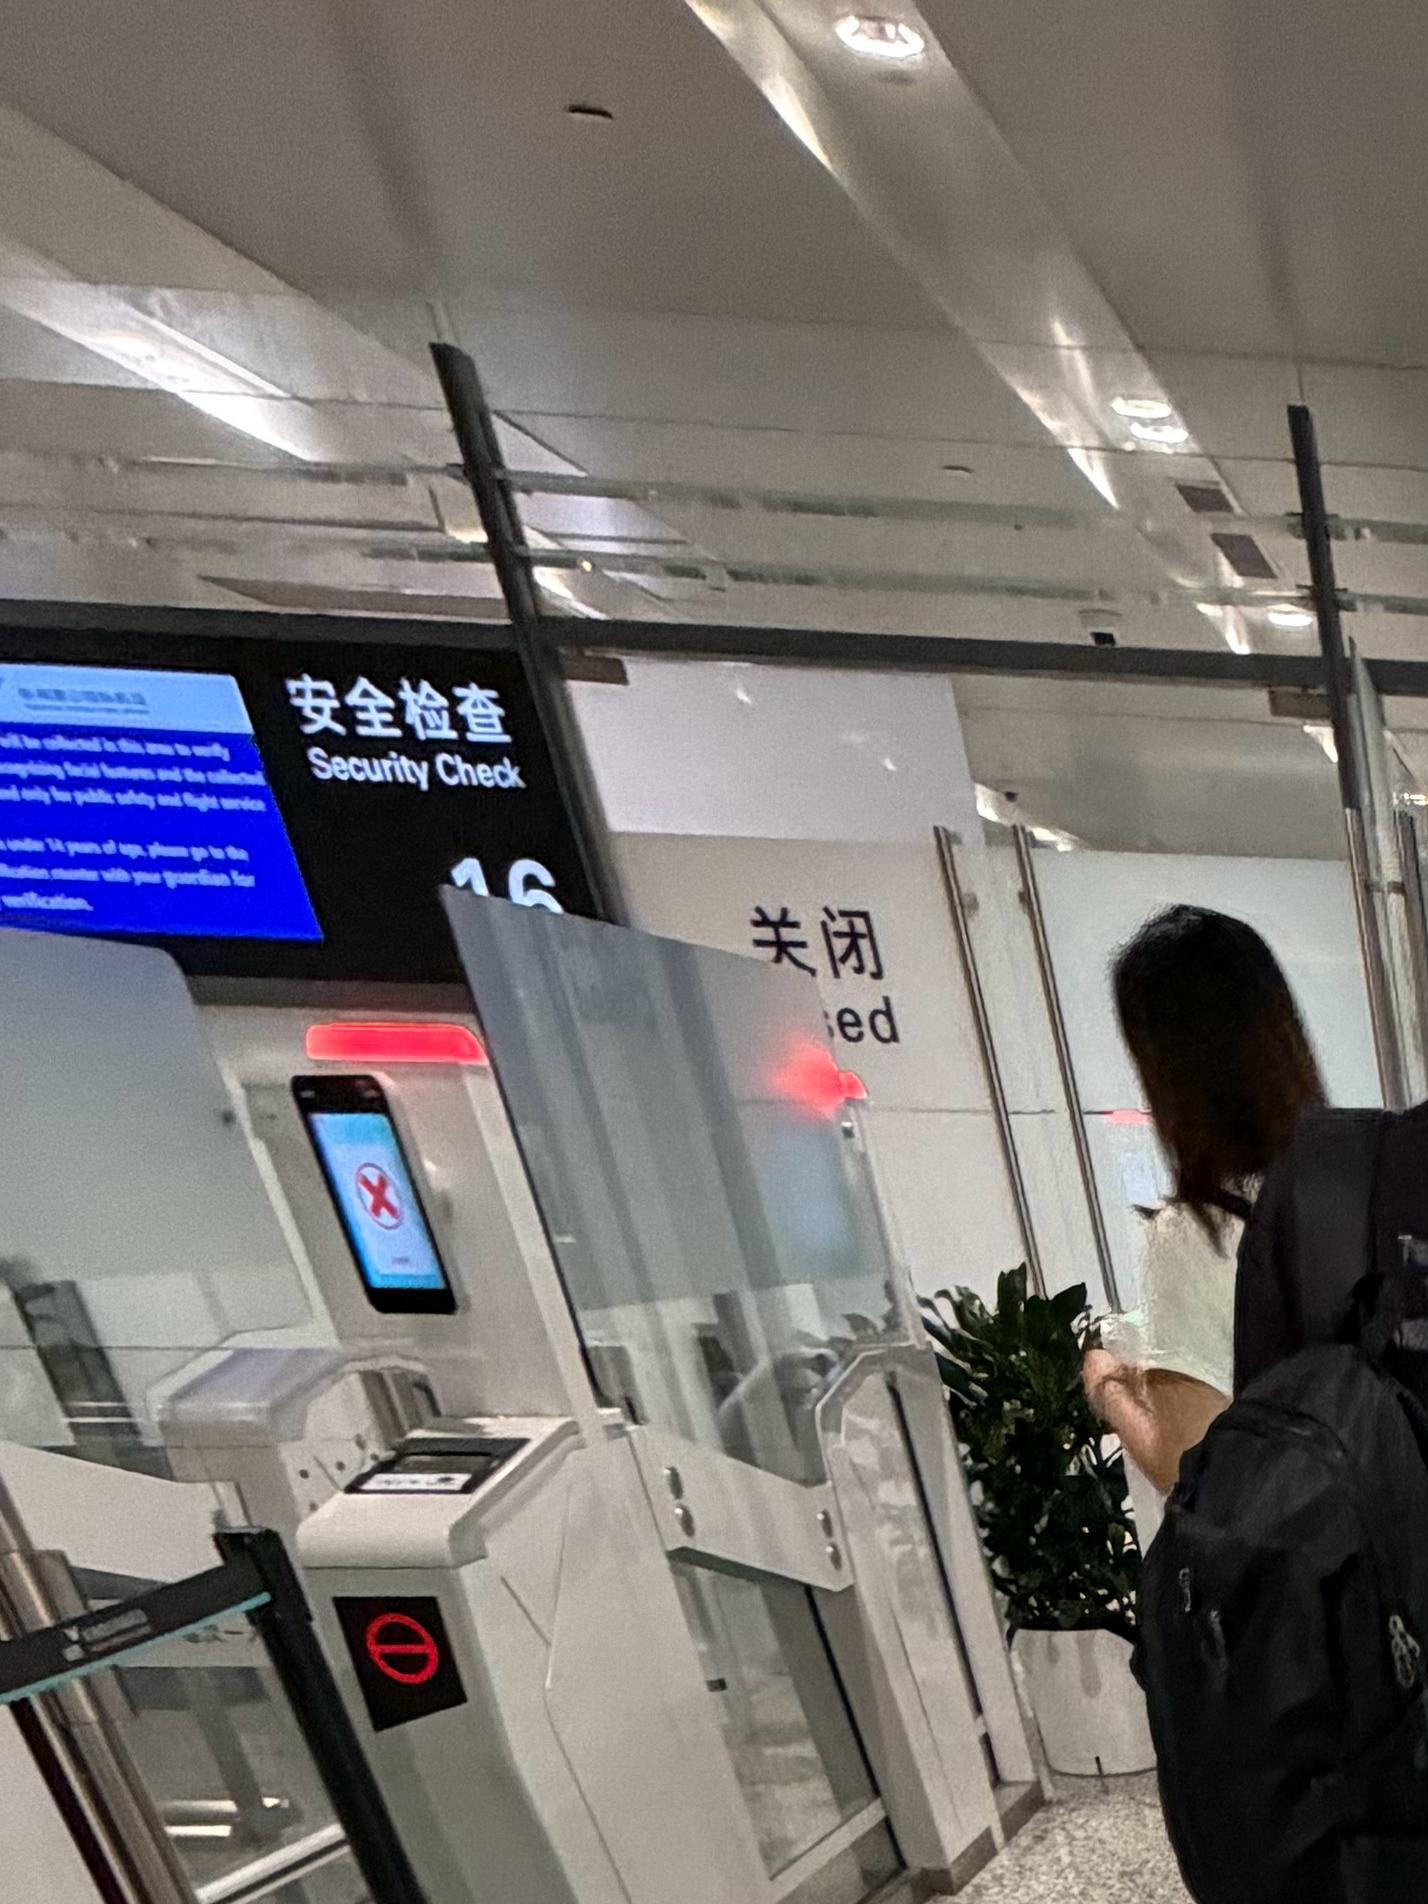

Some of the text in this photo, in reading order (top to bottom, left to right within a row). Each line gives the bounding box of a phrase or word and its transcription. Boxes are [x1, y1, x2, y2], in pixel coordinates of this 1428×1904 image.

[285, 673, 512, 743] 安全检查
[307, 747, 527, 791] Security Check
[750, 905, 883, 980] 关闭
